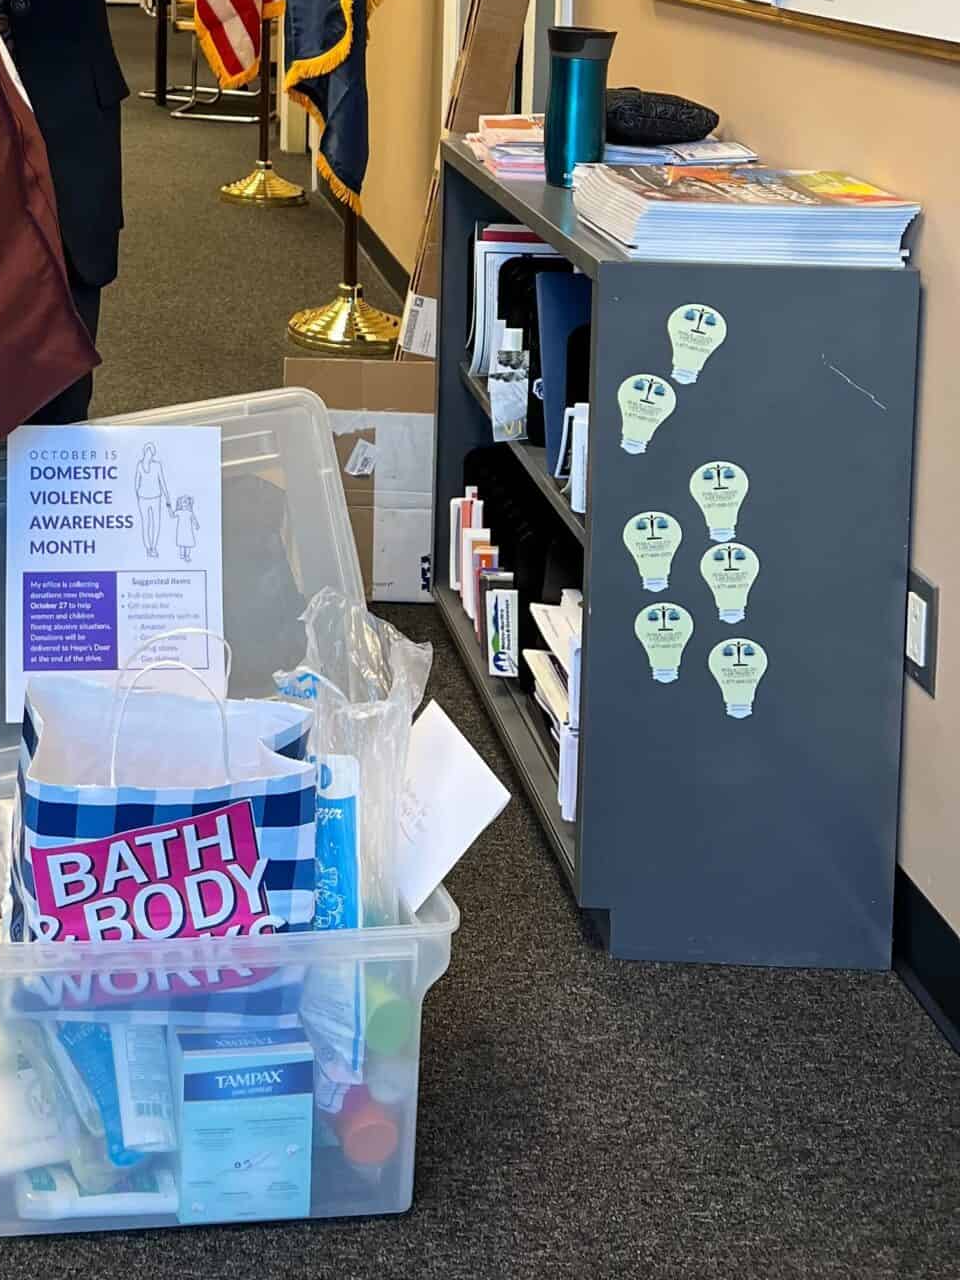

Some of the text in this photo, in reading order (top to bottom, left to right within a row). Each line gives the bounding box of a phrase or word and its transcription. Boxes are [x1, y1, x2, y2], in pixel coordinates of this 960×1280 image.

[30, 450, 117, 460] OCTOBER IS
[30, 466, 118, 480] DOMESTIC
[30, 490, 113, 505] VIOLENCE
[29, 515, 134, 530] AWARENESS
[30, 540, 96, 554] MONTH
[30, 602, 57, 610] October
[47, 814, 235, 909] BATH
[84, 858, 271, 958] BODY
[216, 1071, 282, 1089] TAMPAX
